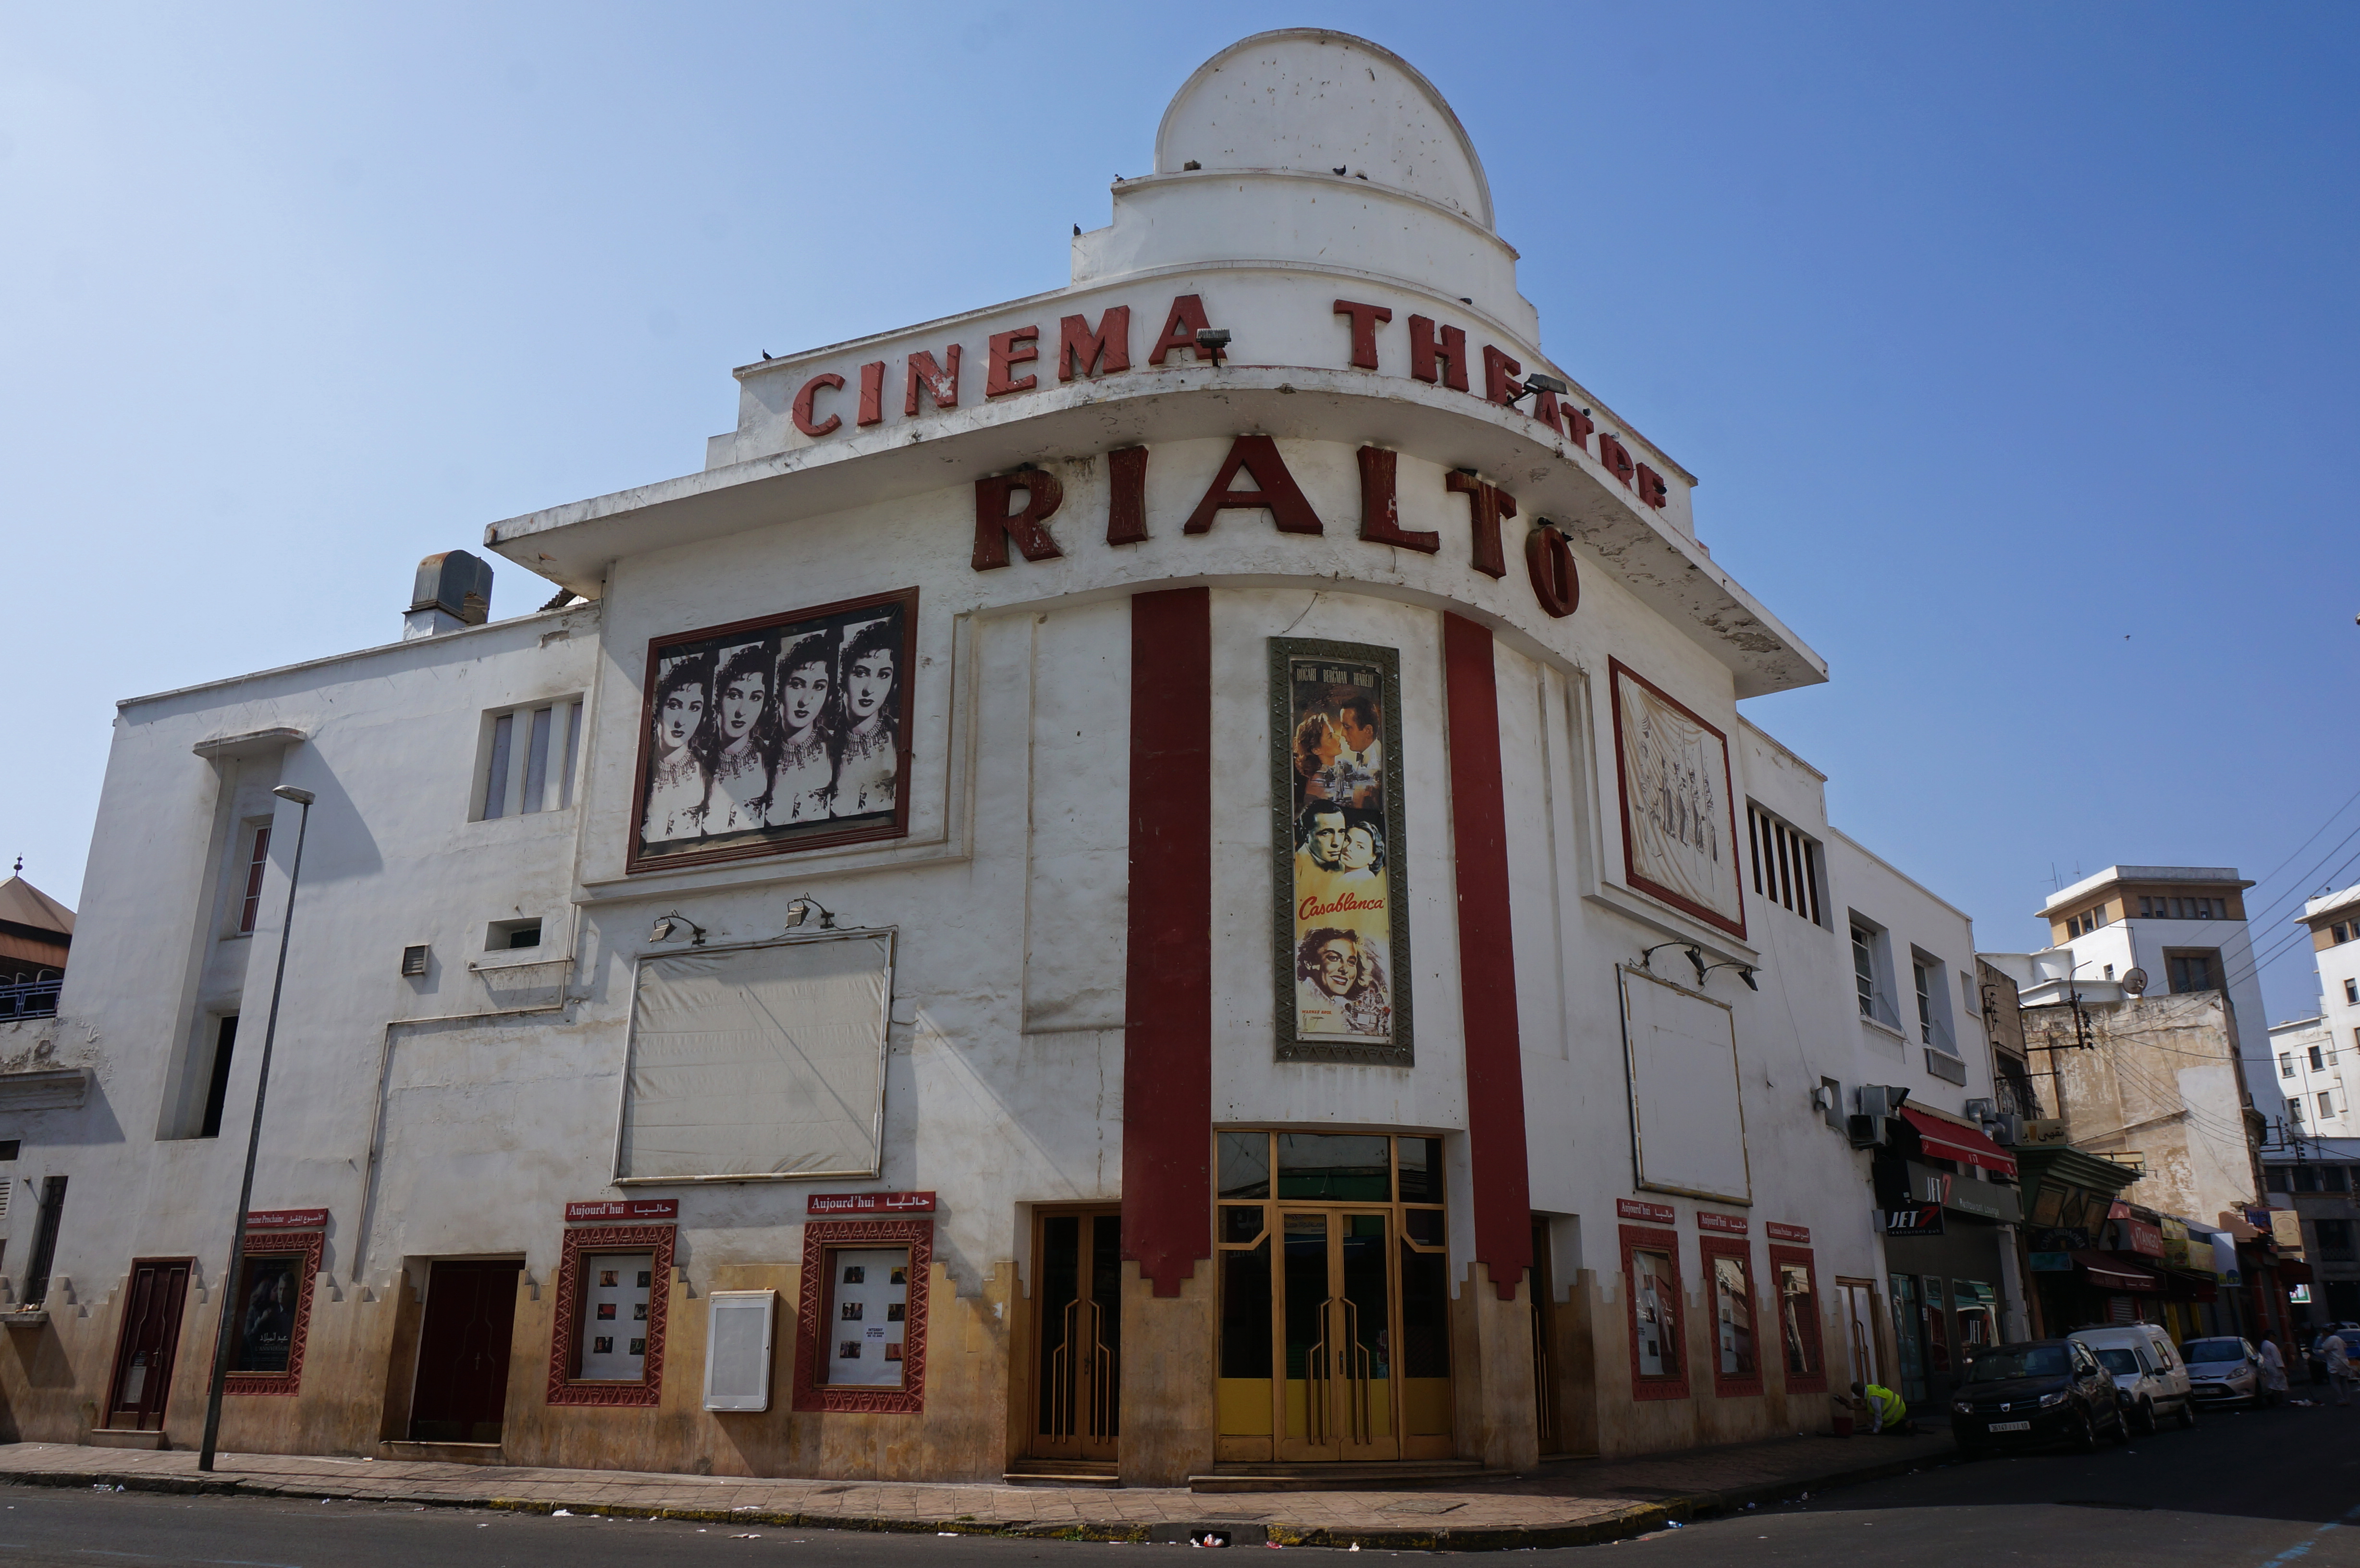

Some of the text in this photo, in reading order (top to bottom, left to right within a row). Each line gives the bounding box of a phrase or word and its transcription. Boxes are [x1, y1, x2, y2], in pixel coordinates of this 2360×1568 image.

[793, 294, 1666, 509] CINEMA THEATRE
[971, 435, 1580, 619] RIALTO
[1297, 668, 1374, 687] BOGART BERGMAN HENREID
[569, 1203, 624, 1219] Aujourd'hui
[811, 1196, 874, 1212] Aujourd'hui
[1622, 1201, 1651, 1216] Aujourd'hui
[262, 1214, 284, 1224] Prochaine
[1701, 1214, 1727, 1228] Aujourd'hui
